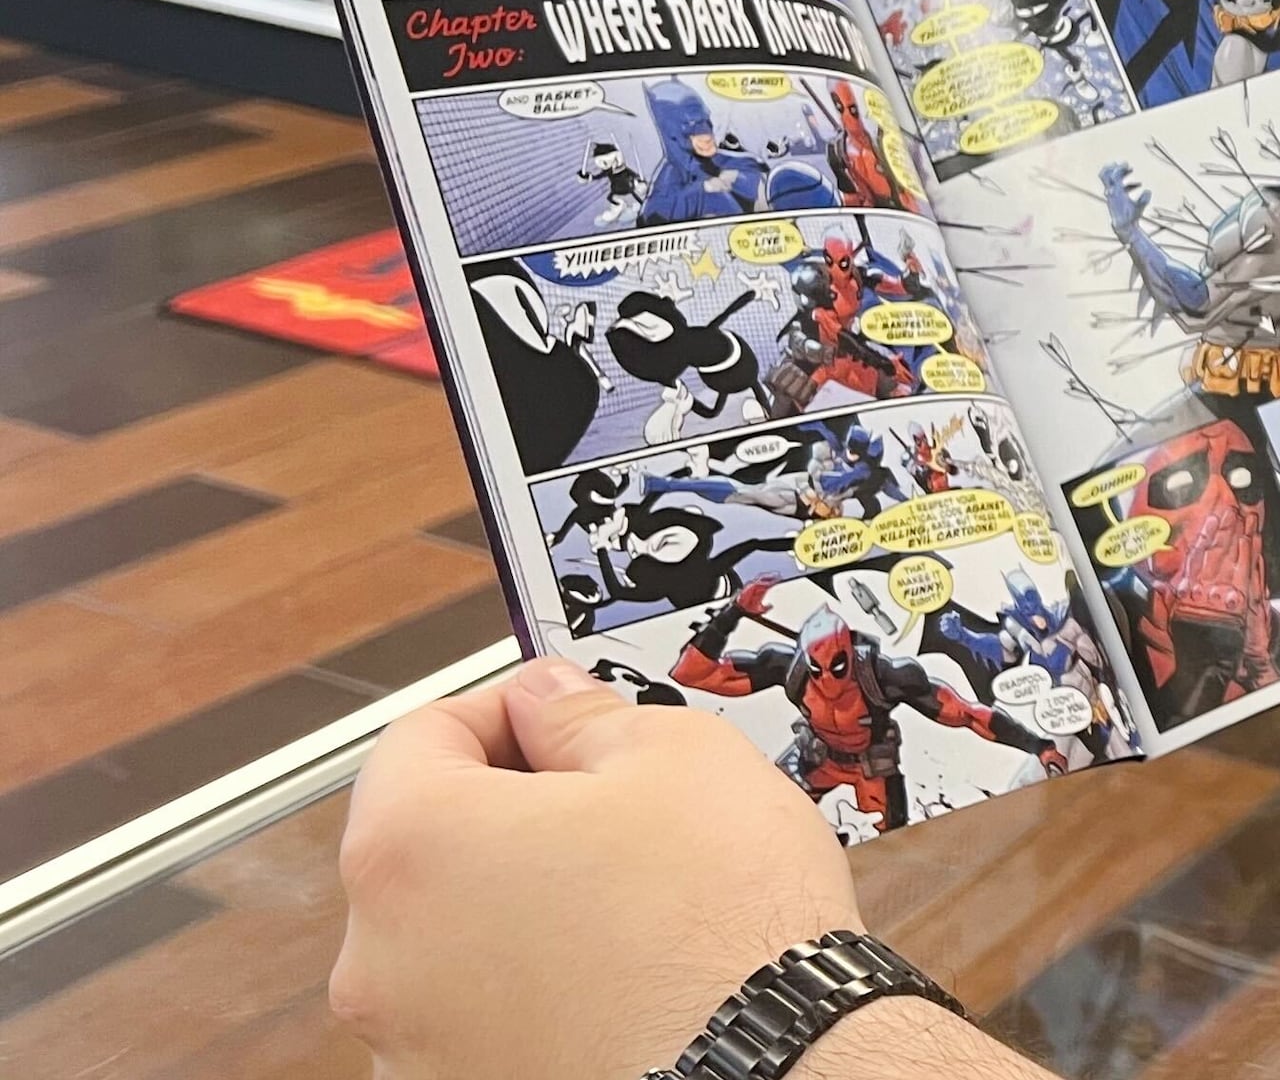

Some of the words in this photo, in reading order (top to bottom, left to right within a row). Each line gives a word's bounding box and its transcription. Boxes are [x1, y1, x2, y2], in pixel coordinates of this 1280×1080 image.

[405, 6, 538, 43] Chapter
[442, 43, 526, 78] Two:
[506, 95, 529, 106] AND
[534, 88, 598, 102] BASKET-
[736, 238, 750, 249] TO
[754, 236, 780, 247] LIVE
[886, 330, 915, 340] GURU
[966, 500, 1006, 513] AGAINST
[814, 524, 847, 538] DEATH
[803, 543, 816, 553] BY
[820, 530, 863, 549] HAPPY
[908, 536, 931, 548] EVIL
[812, 540, 864, 563] ENDING!
[903, 561, 926, 575] THAT
